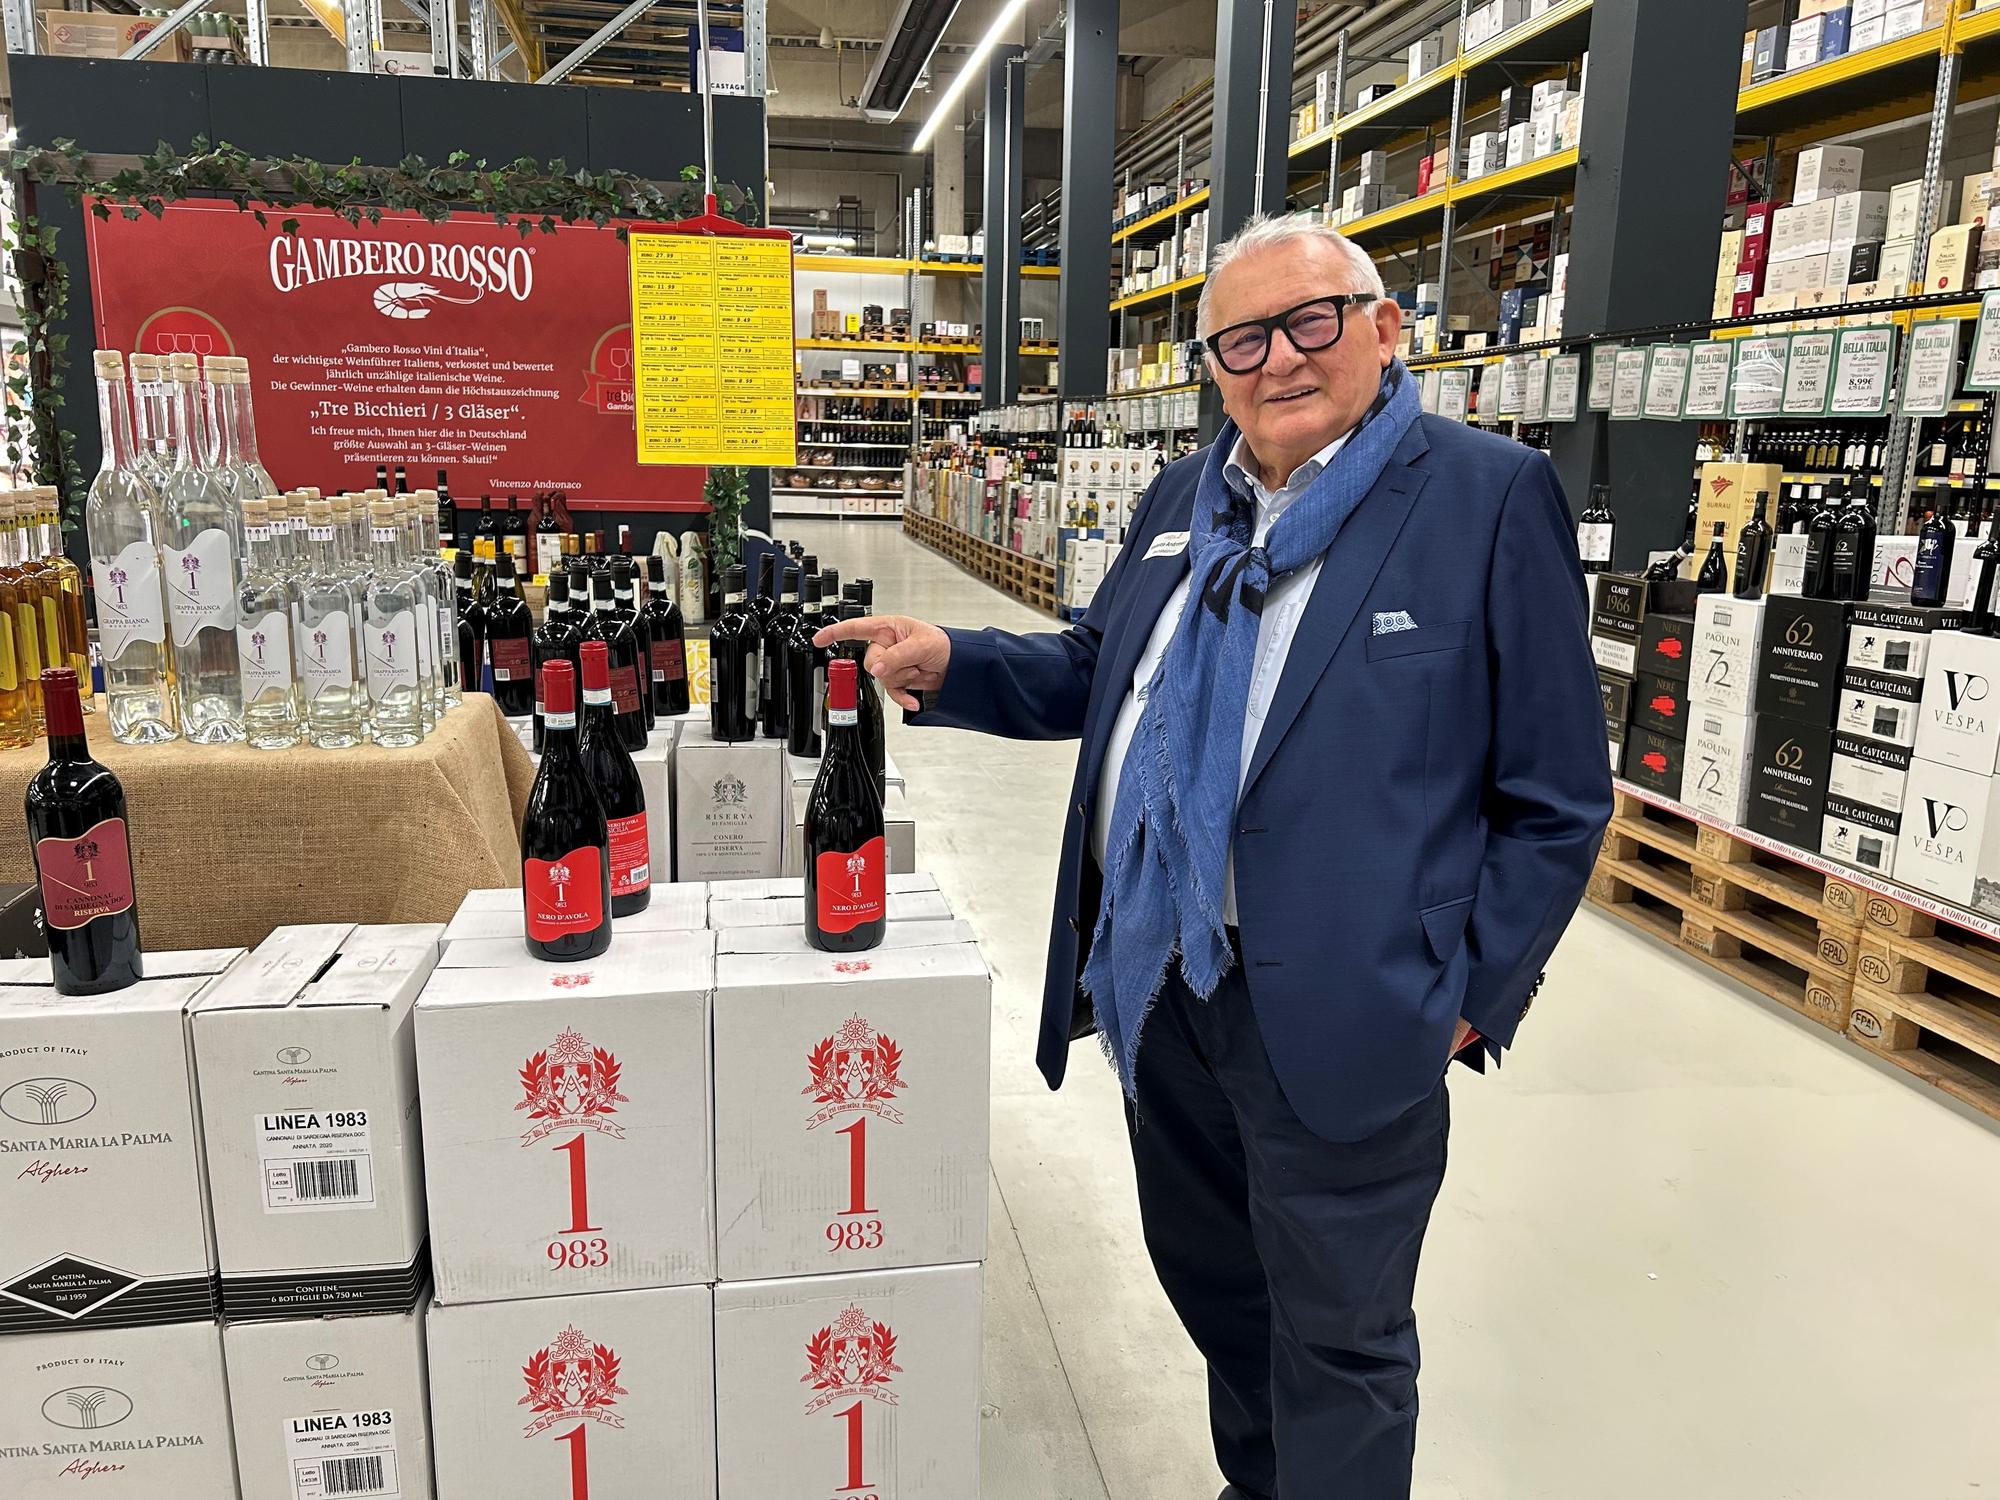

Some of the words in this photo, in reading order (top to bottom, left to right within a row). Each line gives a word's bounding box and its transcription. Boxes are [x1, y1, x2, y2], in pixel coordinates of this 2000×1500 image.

[270, 236, 425, 293] GAMBERO
[428, 243, 534, 301] ROSSO
[341, 343, 391, 354] „Gambero
[393, 345, 421, 355] Rosso
[423, 346, 443, 355] Vini
[1793, 346, 1811, 356] BELLA
[1812, 346, 1830, 356] ITALIA
[1842, 342, 1864, 354] BELLA
[1866, 341, 1887, 353] ITALIA
[273, 354, 289, 363] der
[292, 354, 343, 366] wichtigste
[345, 357, 401, 366] Weinführer
[404, 359, 443, 369] Italiens,
[445, 361, 490, 370] verkostet
[492, 361, 511, 370] und
[513, 362, 554, 372] bewertet
[326, 369, 363, 380] jährlich
[366, 371, 414, 382] unzählige
[416, 372, 471, 383] italienische
[472, 374, 505, 384] Weine.
[271, 381, 287, 390] Die
[290, 381, 374, 393] Gewinner-Weine
[376, 384, 416, 393] erhalten
[418, 385, 443, 395] dann
[445, 386, 460, 396] die
[462, 386, 560, 400] Höchstauszeichnung
[310, 401, 349, 418] „Tre
[354, 402, 427, 418] Bicchieri
[432, 403, 439, 420] /
[444, 405, 454, 420] 3
[458, 403, 526, 420] Gläser“.
[311, 426, 327, 435] Ich
[329, 426, 354, 436] freue
[357, 427, 385, 438] mich,
[387, 427, 416, 437] Ihnen
[418, 428, 436, 438] hier
[439, 428, 454, 438] die
[456, 429, 467, 438] in
[469, 429, 527, 440] Deutschland
[333, 440, 365, 451] größte
[367, 440, 408, 450] Auswahl
[410, 442, 423, 450] an
[426, 442, 507, 452] 3-Gläser-Weinen
[344, 453, 404, 464] präsentieren
[407, 455, 418, 463] zu
[421, 453, 460, 464] können.
[489, 479, 531, 489] Vincenzo
[533, 479, 582, 489] Andronaco
[116, 585, 124, 603] 1
[1611, 585, 1630, 596] CLASSE
[1605, 594, 1630, 614] 1966
[1617, 620, 1635, 631] CARLO
[1855, 610, 1878, 622] VILLA
[1880, 613, 1924, 627] CAVICIANA
[1705, 632, 1740, 647] PAOLINI
[1785, 614, 1814, 647] 62
[1772, 646, 1823, 662] ANNIVERSARIO
[1845, 674, 1868, 687] VILLA
[1870, 680, 1912, 696] CAVICIANA
[1934, 709, 1985, 733] VESPA
[1697, 738, 1731, 757] PAOLINI
[1775, 738, 1803, 770] 62
[1836, 739, 1858, 753] VILLA
[1862, 745, 1905, 765] CAVICIANA
[1762, 766, 1812, 787] ANNIVERSARIO
[1827, 801, 1850, 816] VILLA
[1852, 809, 1895, 829] CAVICIANA
[1913, 835, 1964, 864] VESPA
[83, 860, 96, 882] 1
[555, 883, 565, 902] 1
[853, 874, 860, 892] 1
[1768, 839, 1804, 860] ANDRONACO
[1806, 854, 1846, 876] ANDRONACO
[1848, 872, 1889, 893] ANDRONACO
[1891, 888, 1936, 911] ANDRONACO
[1939, 905, 1988, 931] ANDRONACO
[852, 900, 878, 910] D'AVOLA
[1829, 886, 1849, 905] EPAL
[74, 906, 110, 917] RISERVA
[538, 912, 556, 920] NERO
[557, 912, 588, 920] D'AVOLA
[1870, 903, 1893, 924] EPAL
[1823, 943, 1843, 964] EPAL
[1863, 960, 1886, 981] EPAL
[1813, 991, 1832, 1010] EUR
[60, 1047, 88, 1056] ITALY
[264, 1114, 321, 1131] LINEA
[325, 1112, 367, 1128] 1983
[0, 1140, 47, 1153] SANTA
[49, 1137, 99, 1150] MARIA
[102, 1136, 119, 1148] LA
[121, 1132, 172, 1146] PALMA
[17, 1160, 89, 1184] Alghero
[835, 1116, 879, 1216] 1
[552, 1132, 603, 1235] 1
[825, 1220, 884, 1253] 983
[546, 1238, 608, 1271] 983
[28, 1282, 51, 1290] SANTA
[295, 1285, 339, 1293] CONTIENE
[278, 1293, 320, 1302] BOTTIGLIE
[36, 1358, 80, 1372] PRODUCT
[99, 1358, 125, 1366] ITALY
[294, 1416, 348, 1434] LINEA
[352, 1411, 392, 1428] 1983
[42, 1443, 88, 1456] SANTA
[89, 1440, 136, 1453] MARIA
[138, 1439, 154, 1449] LA
[155, 1435, 204, 1448] PALMA
[833, 1400, 876, 1491] 1
[58, 1458, 126, 1480] Alghero
[554, 1422, 589, 1500] 1
